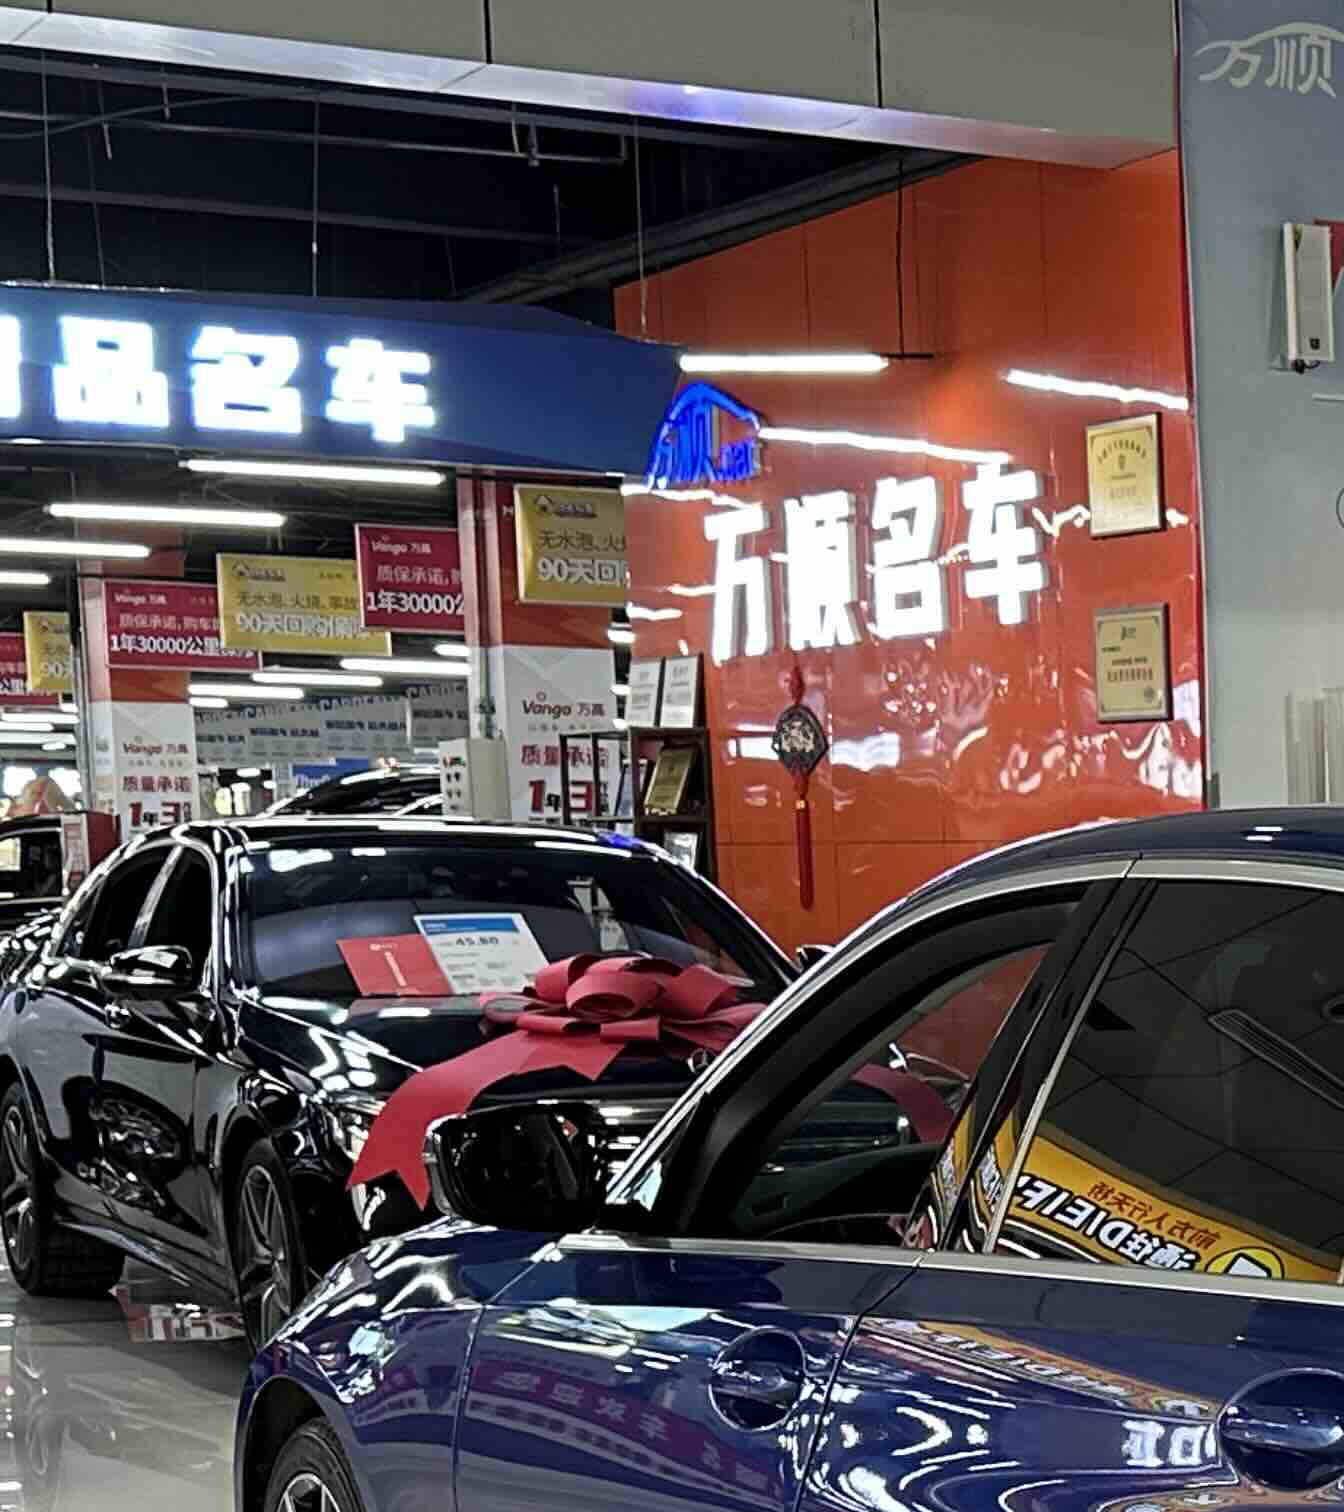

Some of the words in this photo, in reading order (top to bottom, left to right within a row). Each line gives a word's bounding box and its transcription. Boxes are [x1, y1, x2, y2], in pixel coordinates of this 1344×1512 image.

[1196, 33, 1337, 98] 万顺
[0, 313, 438, 442] 品名车
[537, 558, 629, 586] 90天回
[705, 463, 1044, 667] 万顺名车
[110, 635, 255, 658] 1年30000公里
[522, 699, 572, 719] Vango
